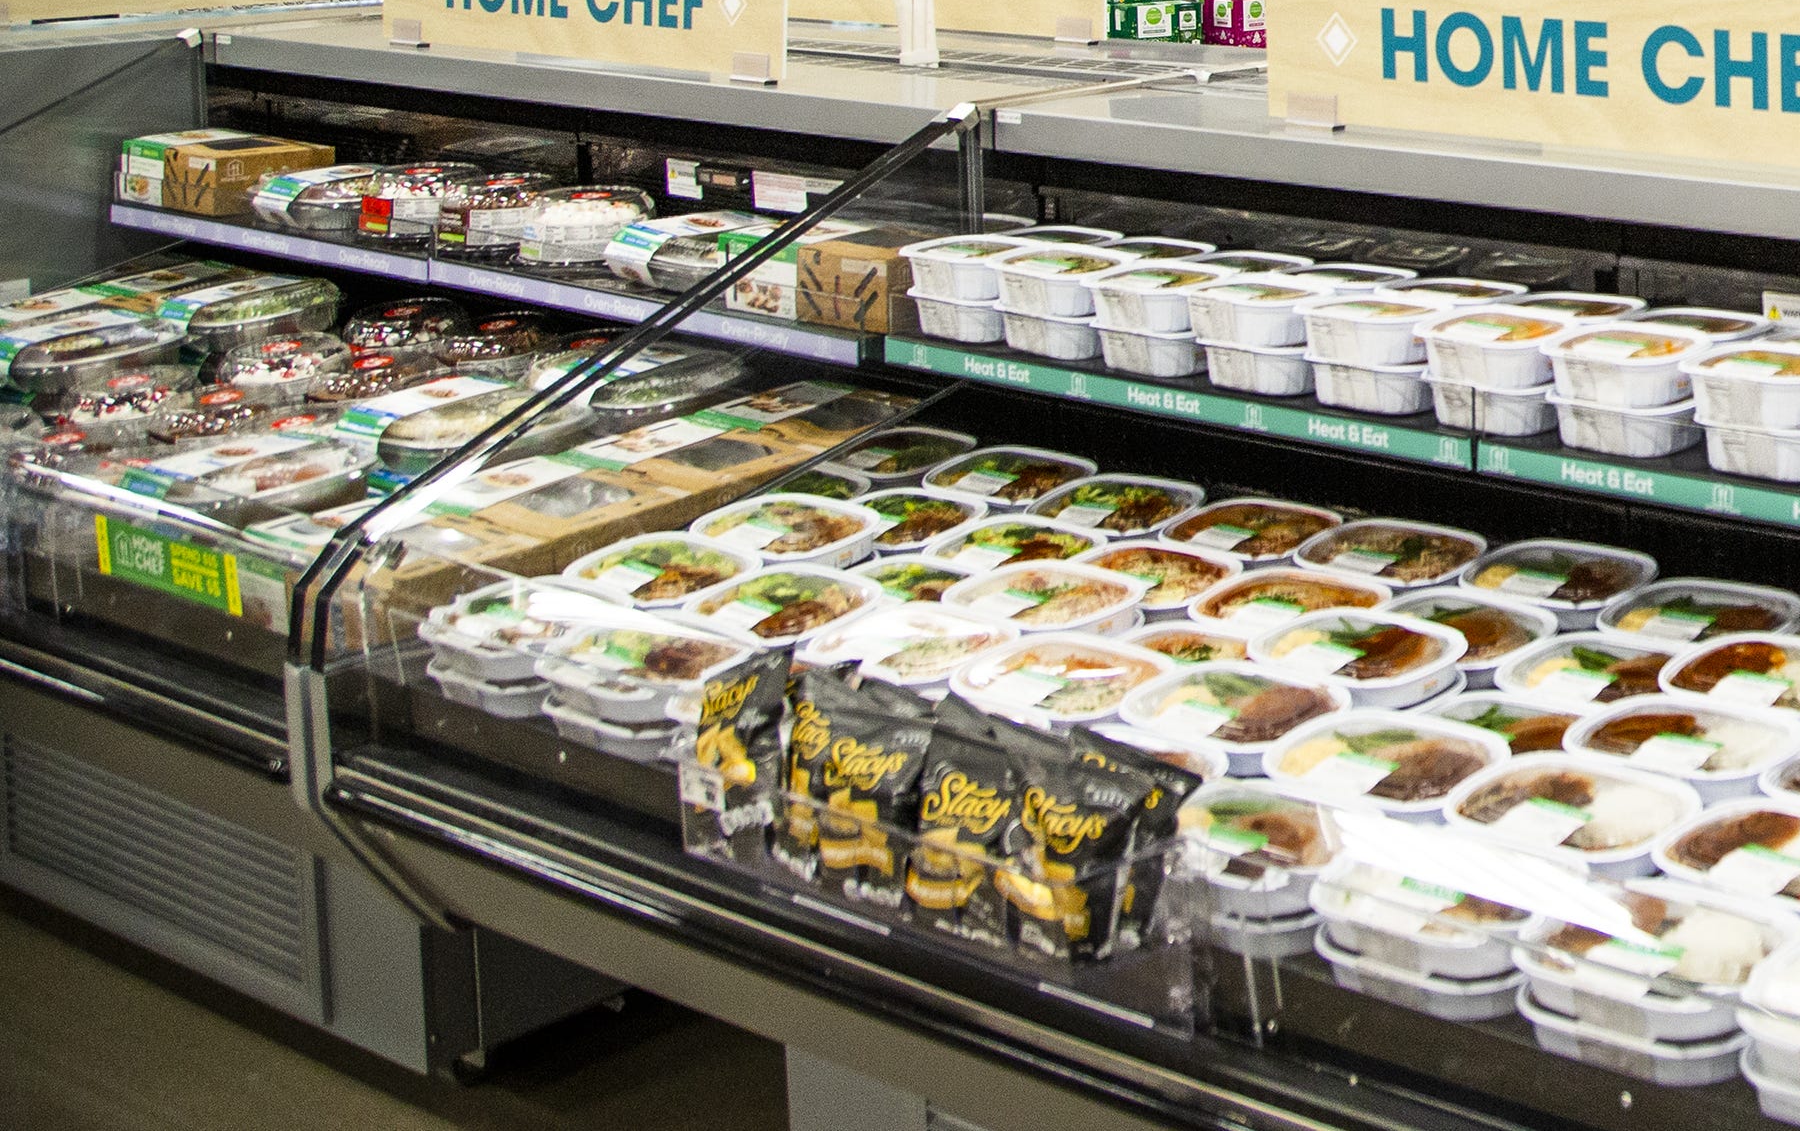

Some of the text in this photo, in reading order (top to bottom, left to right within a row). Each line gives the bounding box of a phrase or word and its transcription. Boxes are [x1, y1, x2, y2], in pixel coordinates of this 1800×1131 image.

[1380, 7, 1609, 98] HOME
[339, 248, 391, 272] Oven-Ready
[467, 271, 526, 296] Oven-Ready
[583, 292, 647, 318] Oven-Ready
[964, 356, 1031, 383] Heat & Eat
[1127, 386, 1200, 414] Heat & Eat
[1308, 418, 1389, 449] Heat & Eat
[1561, 461, 1654, 495] Heat & Eat
[132, 534, 164, 556] HOME
[134, 551, 165, 577] CHEF
